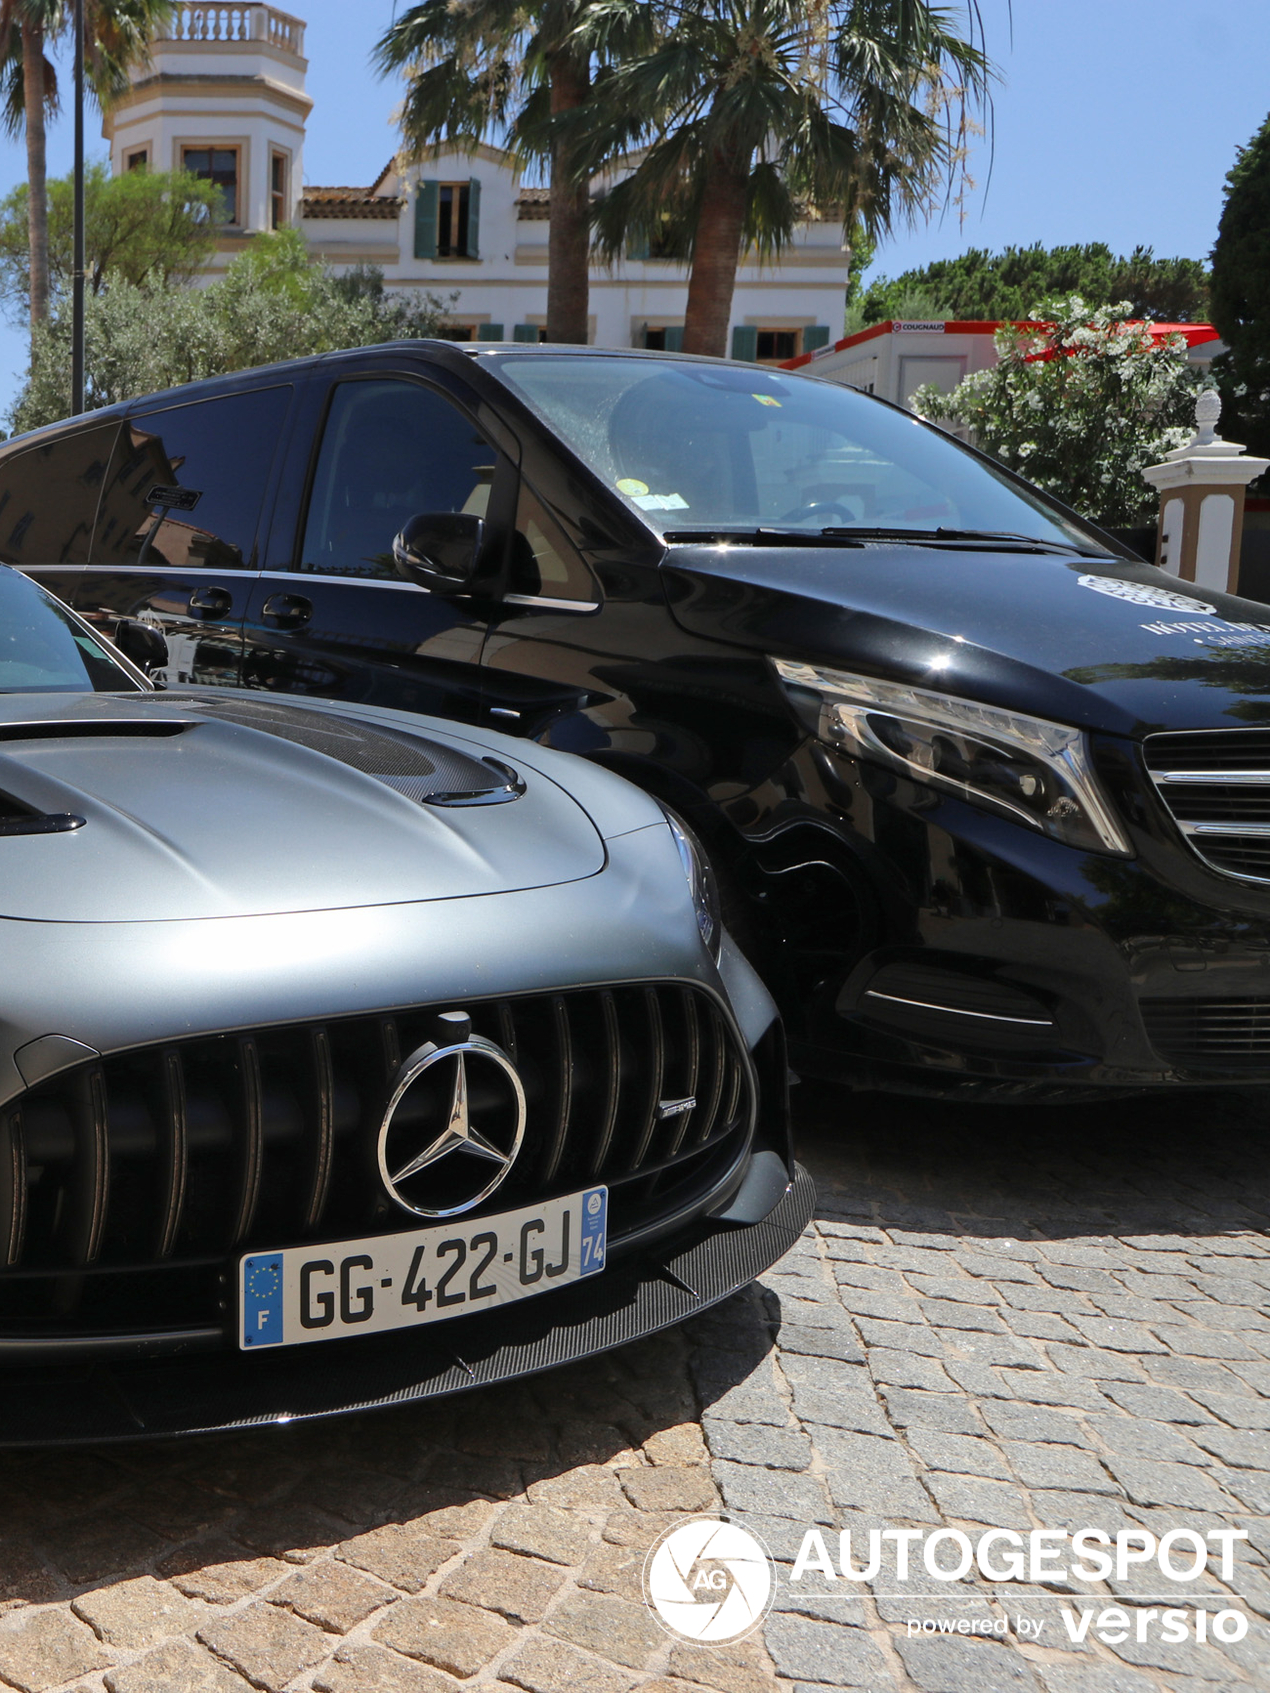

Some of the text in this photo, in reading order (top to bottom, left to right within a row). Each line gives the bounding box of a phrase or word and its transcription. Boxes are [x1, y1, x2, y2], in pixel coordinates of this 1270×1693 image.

[903, 323, 945, 331] COUGNAUD
[1138, 620, 1234, 635] HÔTEL
[583, 1232, 604, 1267] 74
[300, 1210, 571, 1329] GG-422-GJ
[257, 1310, 270, 1330] F
